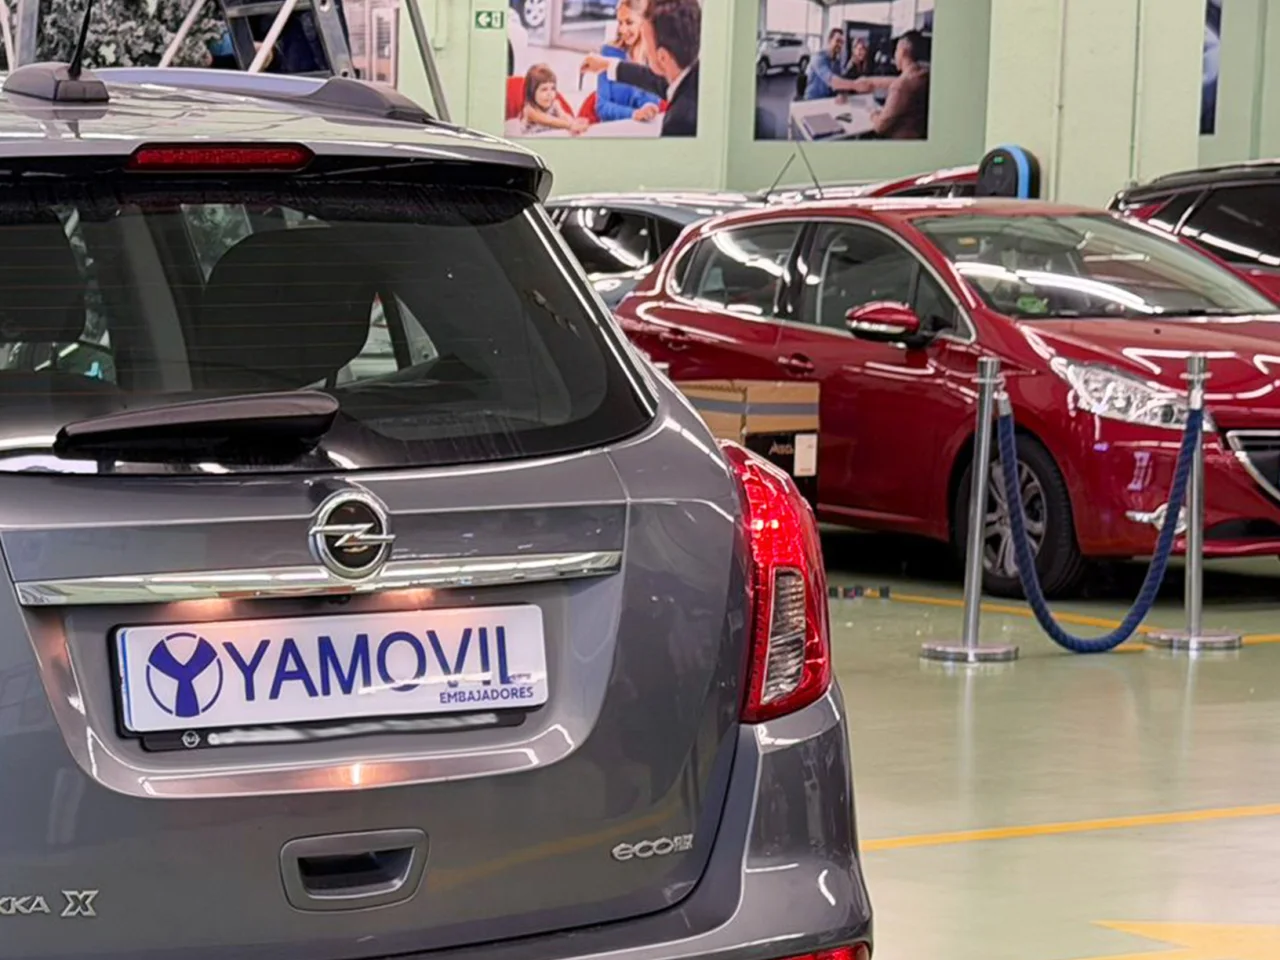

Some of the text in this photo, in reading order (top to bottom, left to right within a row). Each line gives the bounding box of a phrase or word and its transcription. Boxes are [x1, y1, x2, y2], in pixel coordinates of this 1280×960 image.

[222, 624, 532, 702] YAMOVIL
[439, 686, 534, 704] EMBAJADORES
[61, 889, 99, 917] X
